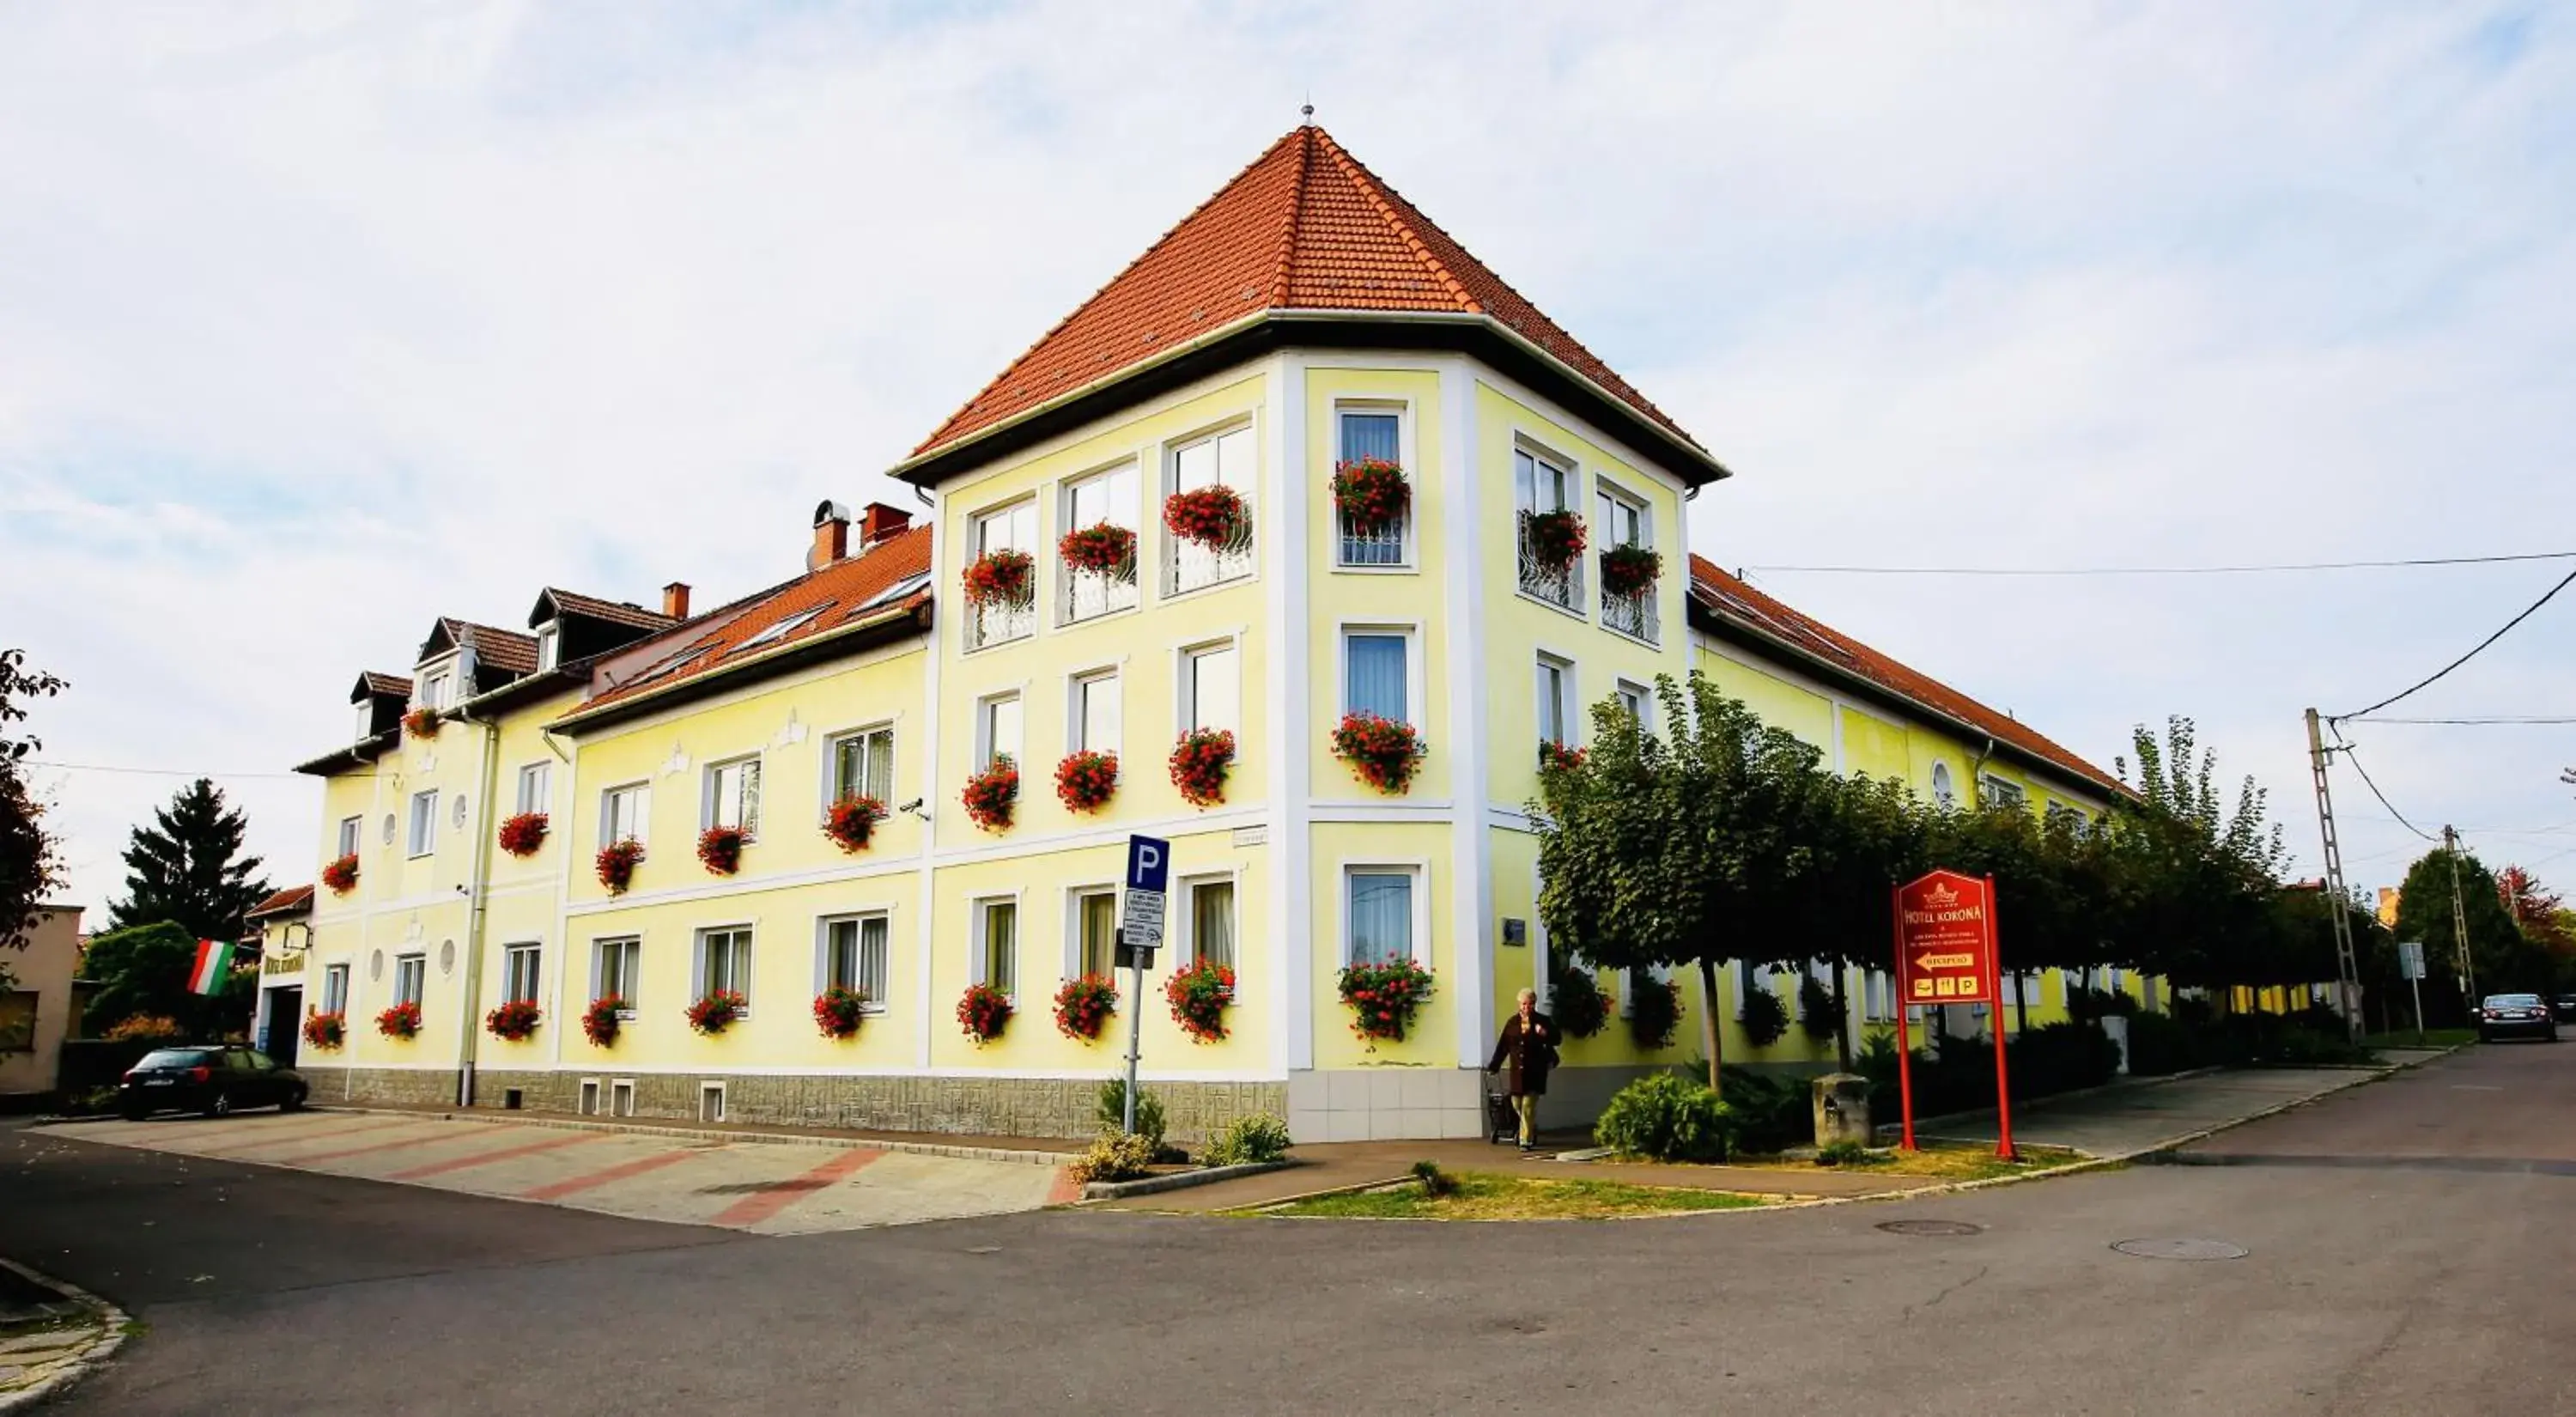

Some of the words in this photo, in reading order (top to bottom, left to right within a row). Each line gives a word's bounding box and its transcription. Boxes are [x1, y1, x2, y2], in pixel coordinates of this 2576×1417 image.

[1136, 844, 1159, 883] P
[1904, 909, 1935, 925] HOTEL
[1937, 905, 1982, 921] KORONA
[1963, 980, 1972, 992] P
